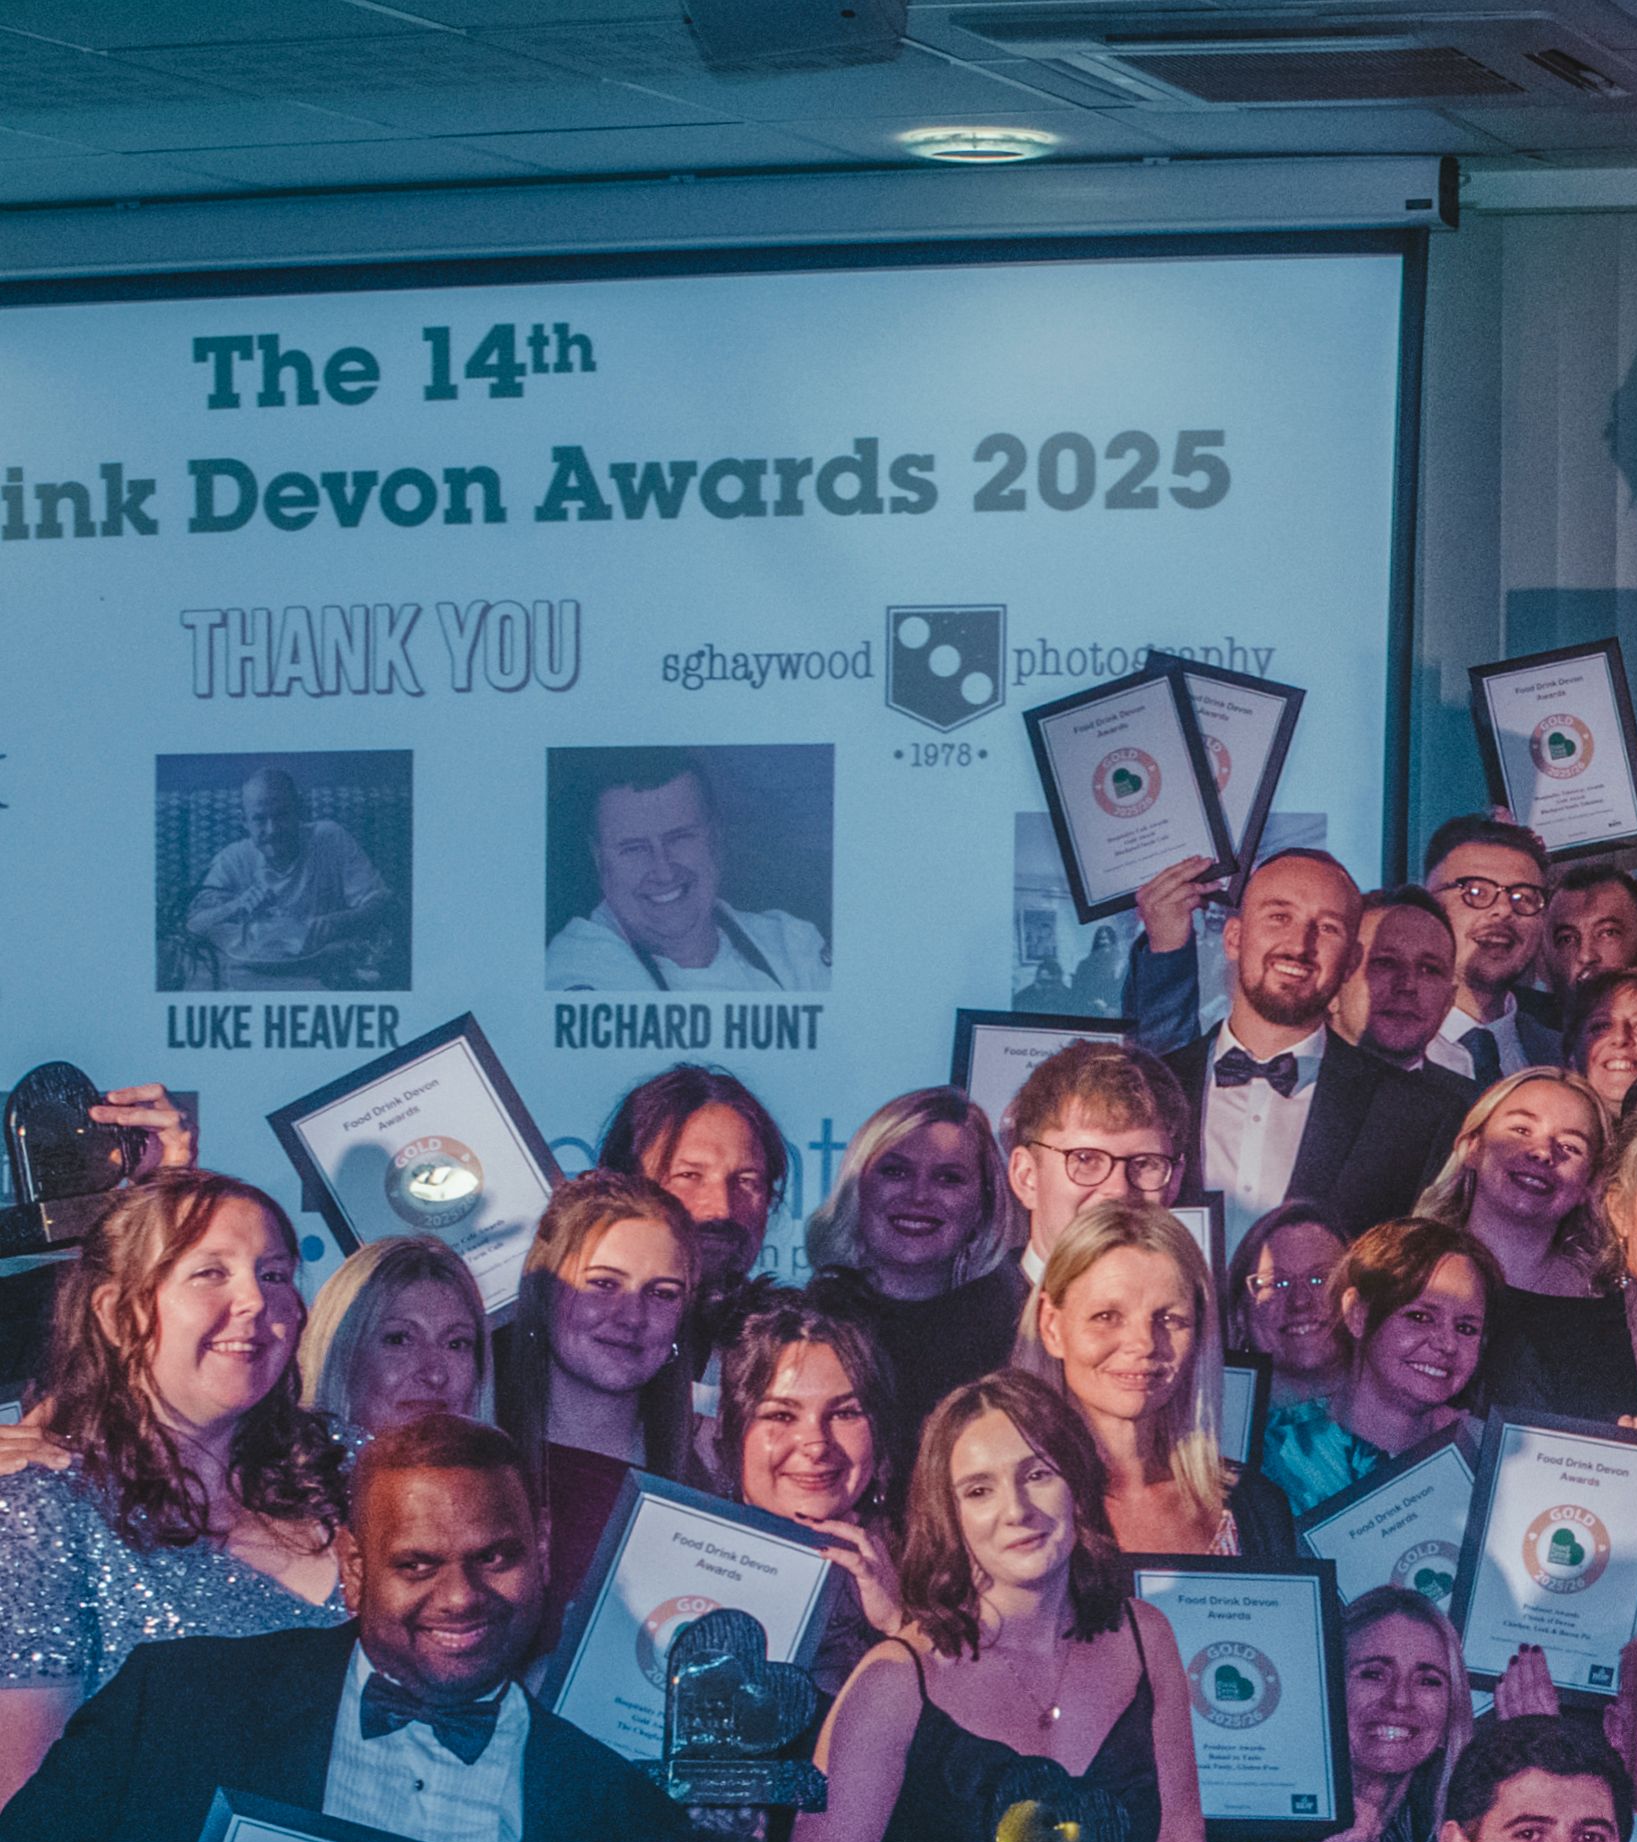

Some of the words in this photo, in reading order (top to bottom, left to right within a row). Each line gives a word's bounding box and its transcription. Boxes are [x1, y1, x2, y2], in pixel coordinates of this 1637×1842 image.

[192, 333, 380, 411] The
[423, 322, 596, 401] 14th
[188, 457, 506, 534] Devon
[534, 437, 939, 523] Awards
[973, 429, 1232, 513] 2025
[179, 602, 425, 698] THANK
[436, 599, 581, 693] YOU
[662, 641, 874, 689] sghaywood
[910, 742, 972, 767] 1978
[168, 1006, 253, 1049] LUKE
[264, 1005, 398, 1049] HEAVER
[554, 1005, 713, 1050] RICHARD
[725, 1004, 823, 1050] HUNT
[671, 1530, 705, 1551] Food
[703, 1542, 737, 1562] Drink
[738, 1553, 778, 1575] Devon
[694, 1557, 742, 1582] Awards
